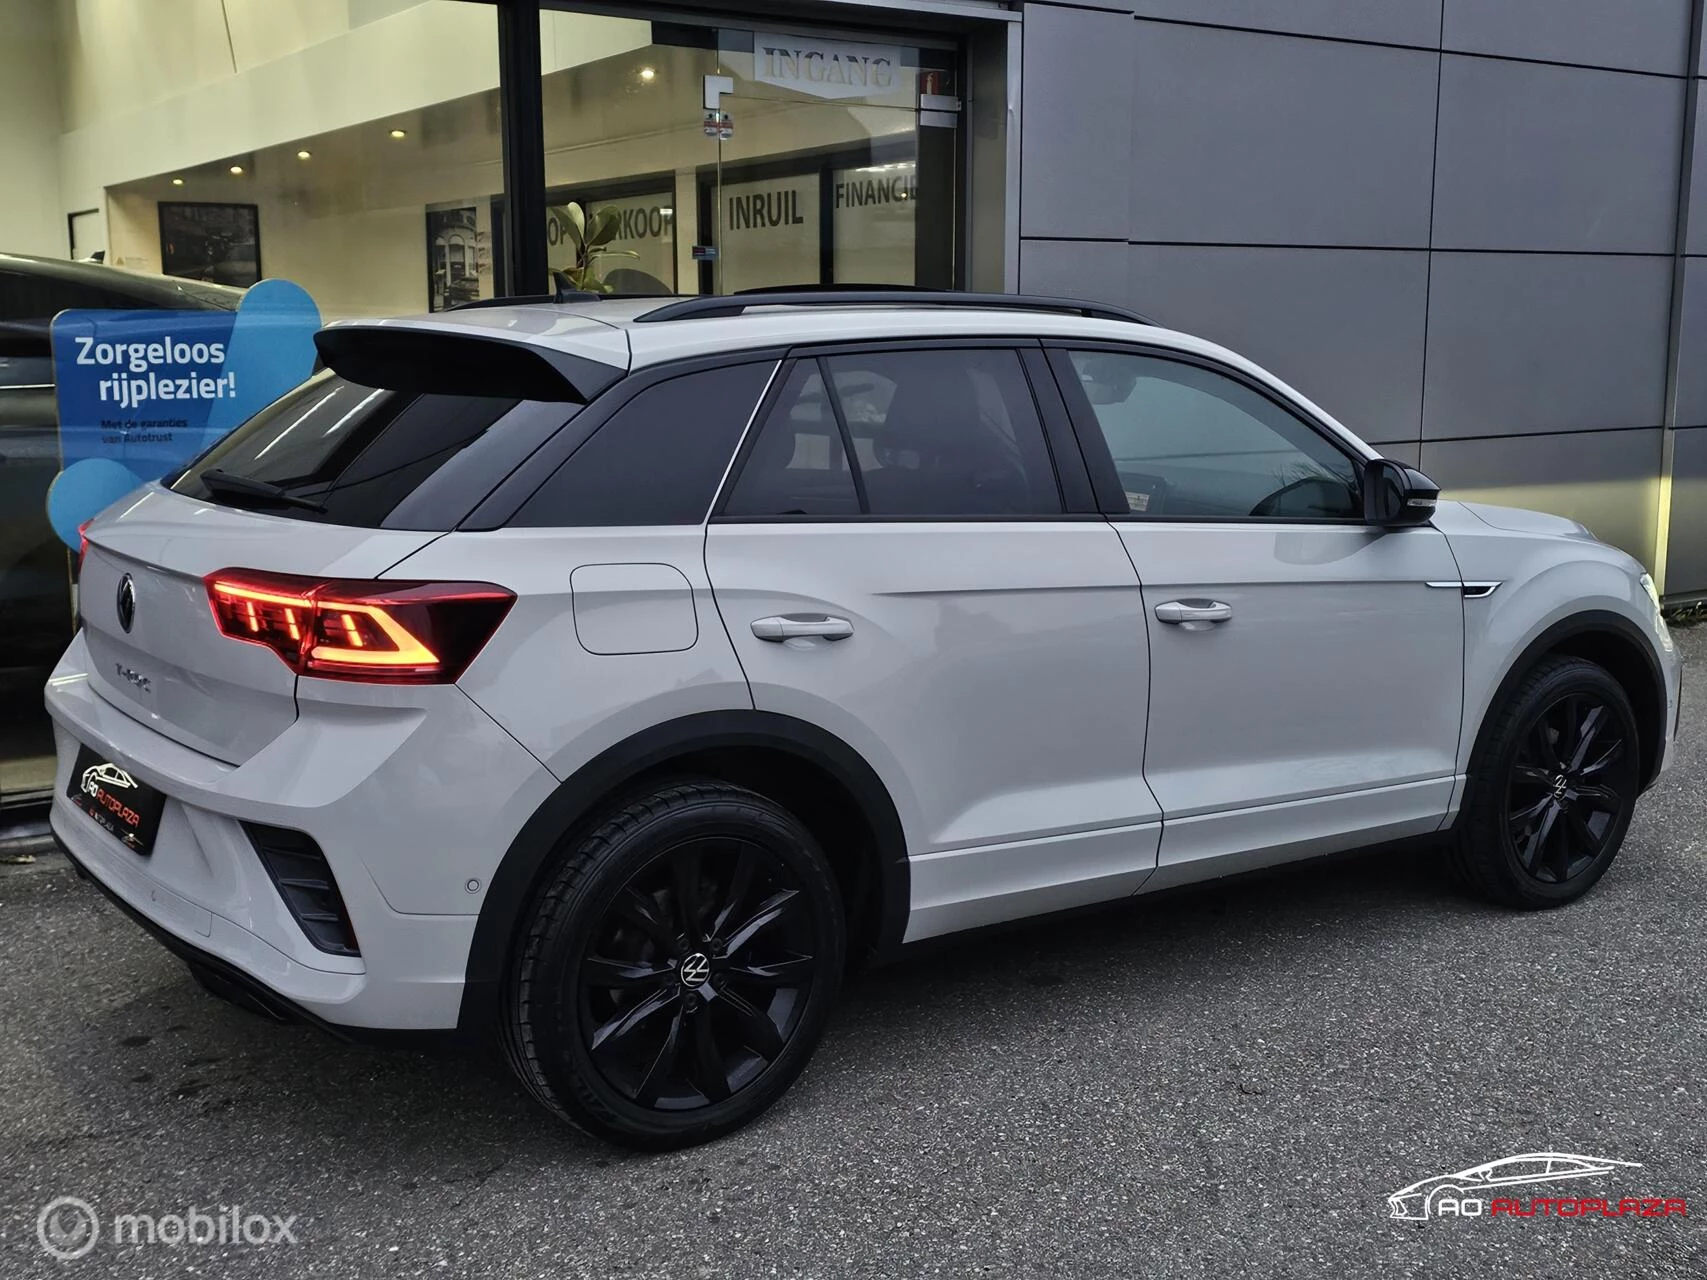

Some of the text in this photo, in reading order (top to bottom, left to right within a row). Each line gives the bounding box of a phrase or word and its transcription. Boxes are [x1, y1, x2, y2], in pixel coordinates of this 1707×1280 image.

[762, 47, 891, 88] INGANG
[729, 190, 804, 231] INRUIL
[75, 336, 225, 372] Zorgeloos
[99, 371, 236, 408] rijplezier!
[101, 417, 188, 431] Met de garanties
[124, 432, 173, 442] Autotrust
[97, 788, 140, 828] AUTOPLAZA
